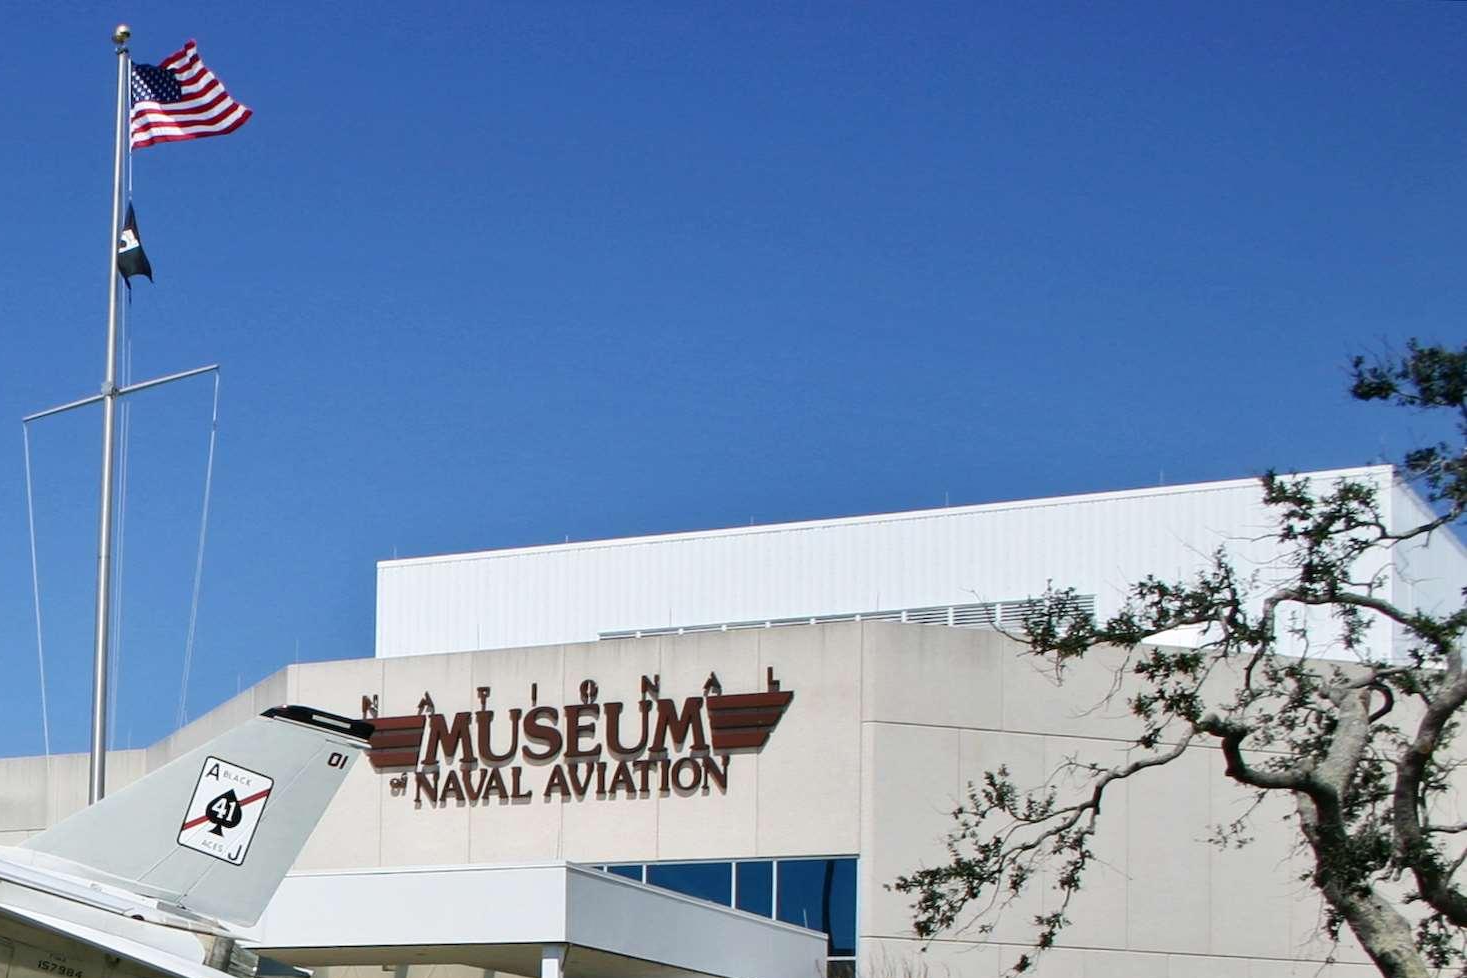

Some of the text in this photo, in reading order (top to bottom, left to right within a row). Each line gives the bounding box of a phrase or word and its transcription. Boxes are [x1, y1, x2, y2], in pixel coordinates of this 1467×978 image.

[362, 666, 781, 712] NATIONAL
[421, 697, 711, 764] MUSEUM
[205, 763, 252, 787] A BLACK
[414, 766, 532, 803] NAVAL
[544, 755, 730, 797] AVIATION
[211, 797, 236, 823] 41
[227, 844, 242, 861] J
